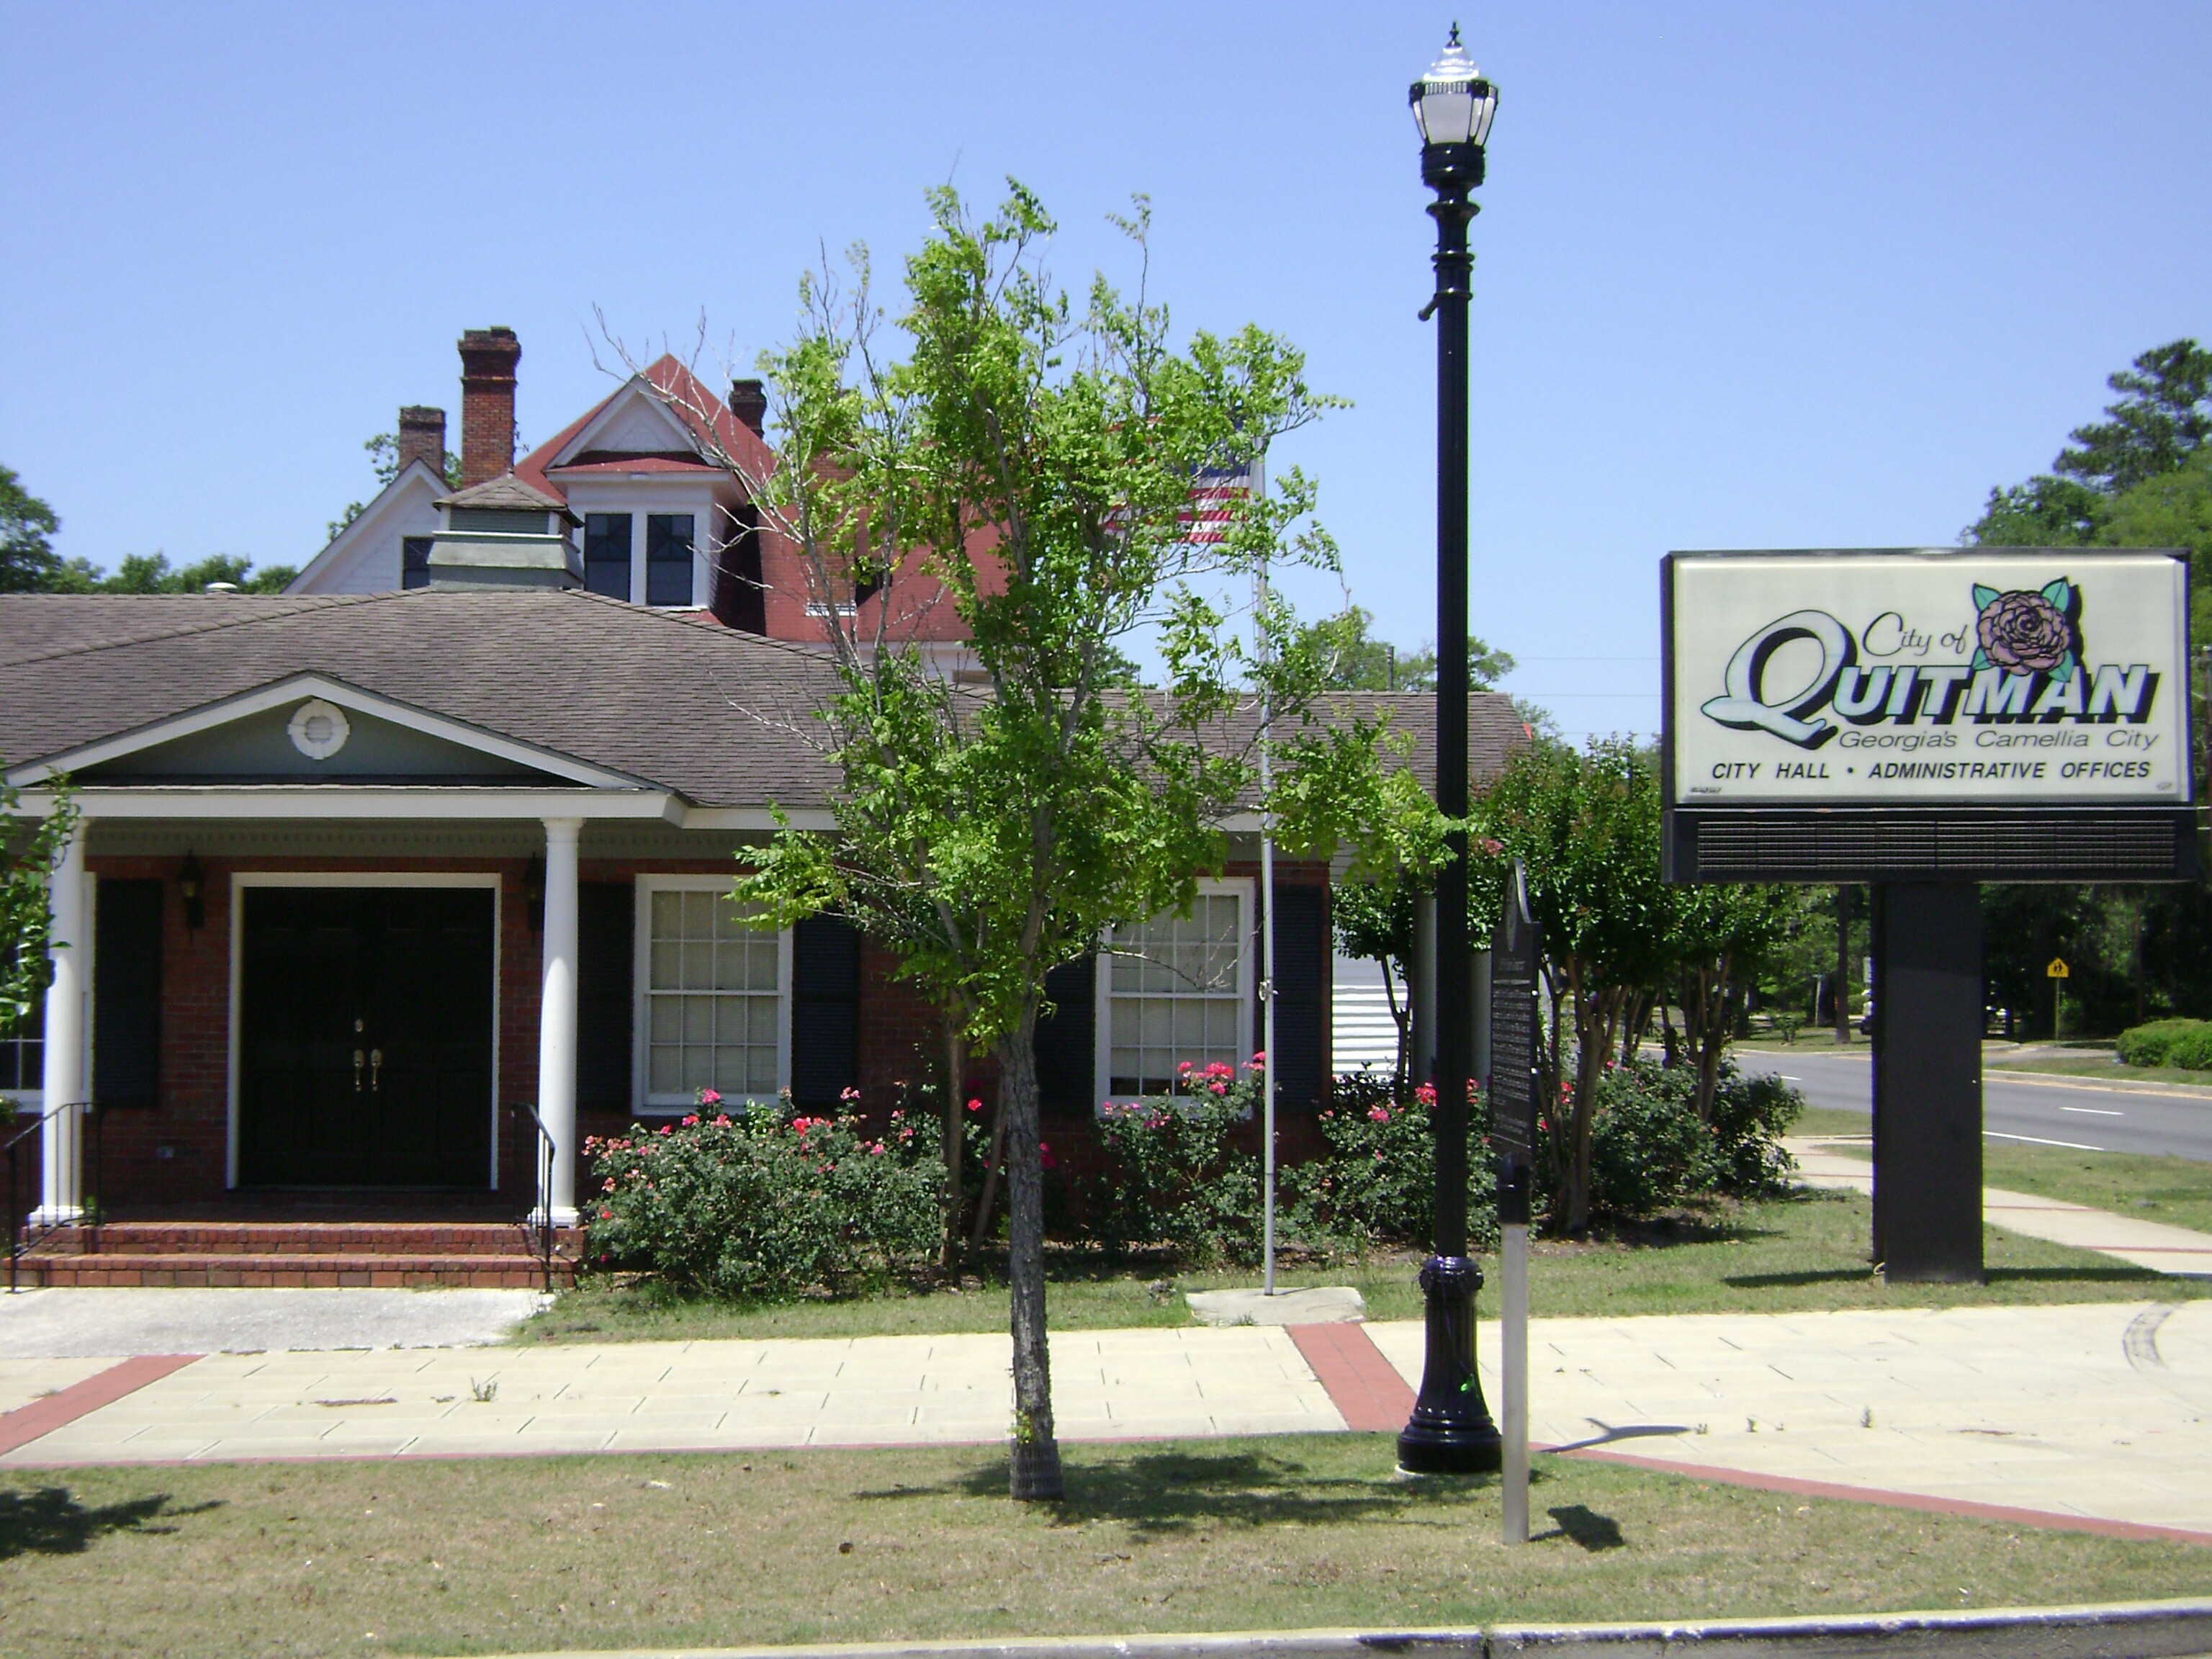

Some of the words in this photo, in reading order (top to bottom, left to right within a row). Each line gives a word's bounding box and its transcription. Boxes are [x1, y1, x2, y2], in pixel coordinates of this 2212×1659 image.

[1863, 612, 1932, 656] City
[1941, 624, 1969, 654] of
[1700, 610, 2161, 750] QUITMAN
[1839, 730, 1958, 751] Georgia's
[1975, 730, 2089, 748] Camellia
[2106, 730, 2159, 751] City
[1712, 763, 1761, 779] CITY
[1776, 763, 1830, 778] HALL
[1869, 762, 2046, 778] ADMINISTRATIVE
[2062, 762, 2150, 778] OFFICES
